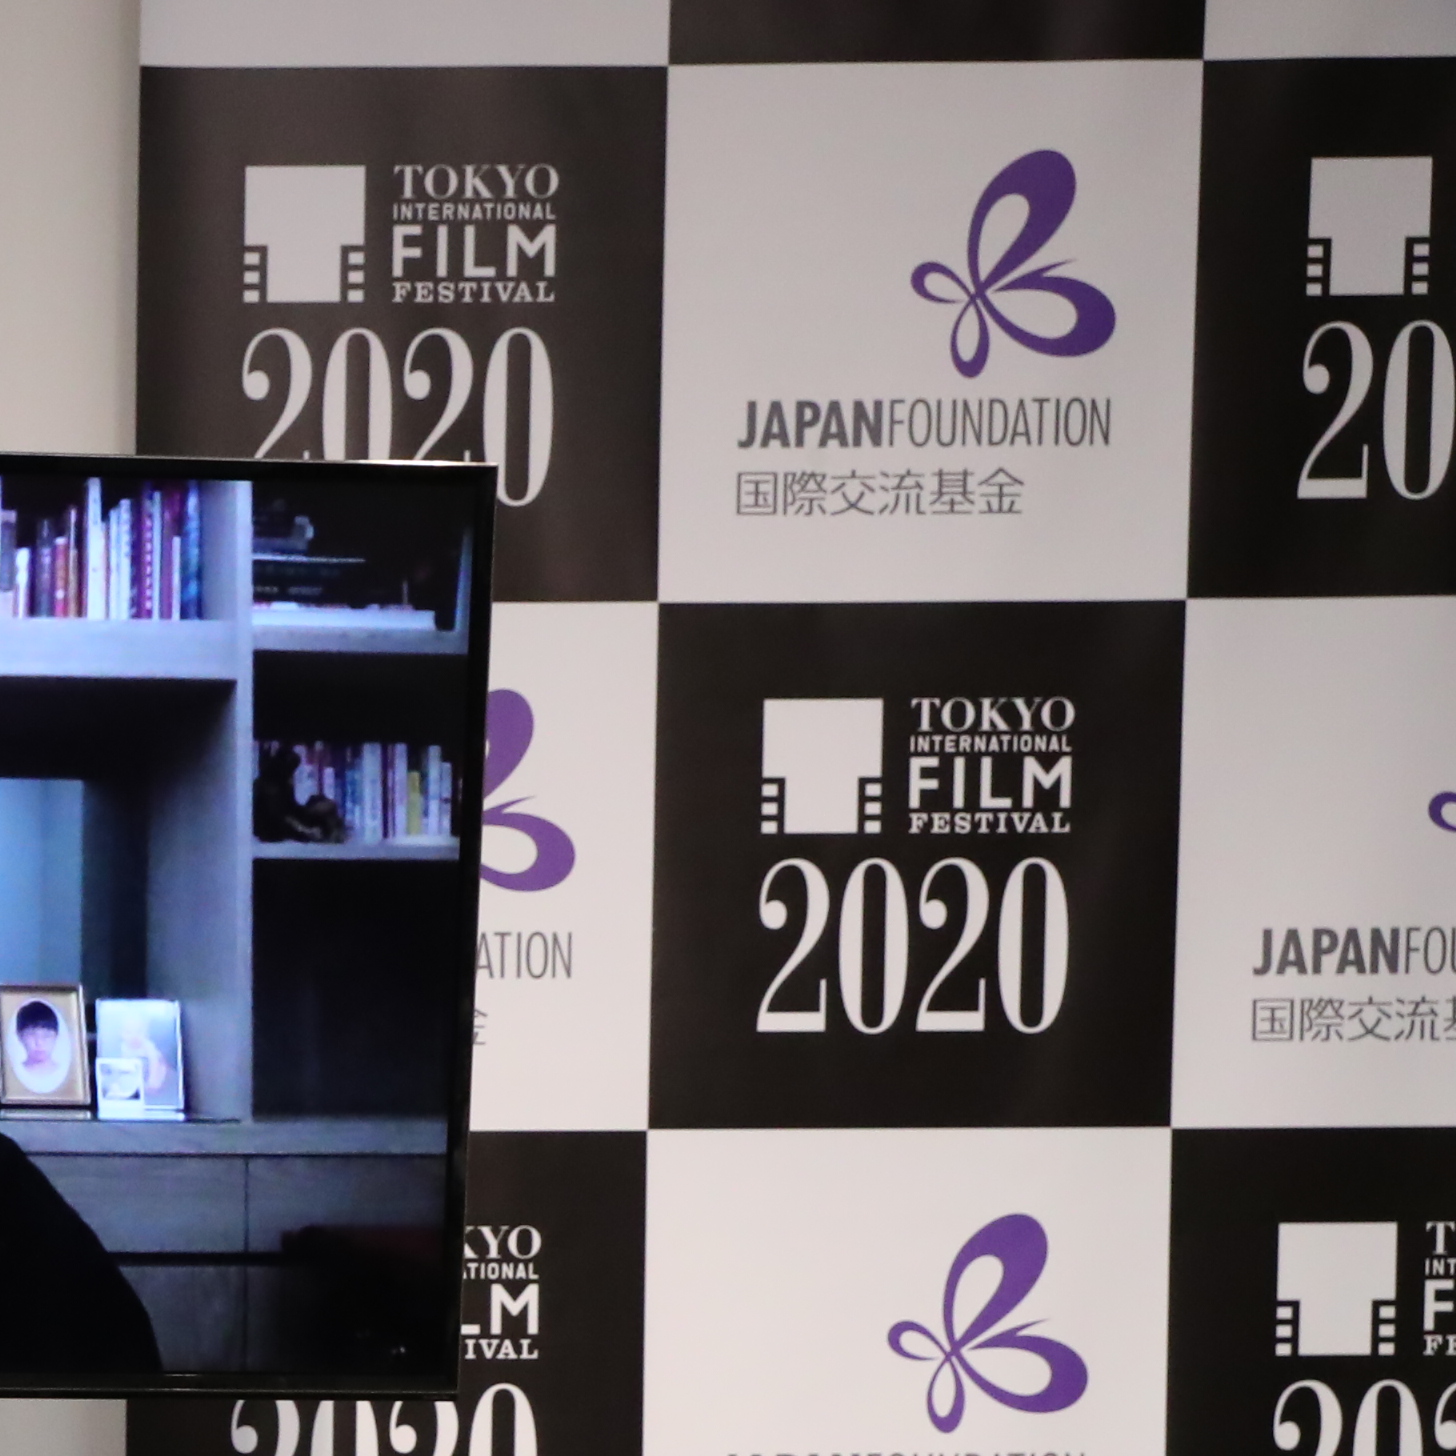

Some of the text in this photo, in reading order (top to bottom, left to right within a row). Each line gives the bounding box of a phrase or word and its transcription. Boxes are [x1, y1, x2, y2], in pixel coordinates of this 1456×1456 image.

[393, 164, 559, 199] TOKYO
[392, 203, 556, 221] INTERNATIONAL
[391, 223, 557, 278] FILM
[391, 281, 555, 304] FESTIVAL
[241, 326, 555, 507] 2020
[737, 396, 1112, 449] JAPANFOUNDATION
[735, 466, 1026, 518] 国際交流基金
[910, 696, 1077, 732] TOKYO
[909, 735, 1073, 753] INTERNATIONAL
[908, 755, 1073, 809] FILM
[908, 812, 1071, 835] FESTIVAL
[755, 856, 1070, 1035] 2020
[1251, 994, 1456, 1043] 国際交流
[463, 1262, 539, 1280] TIONAL
